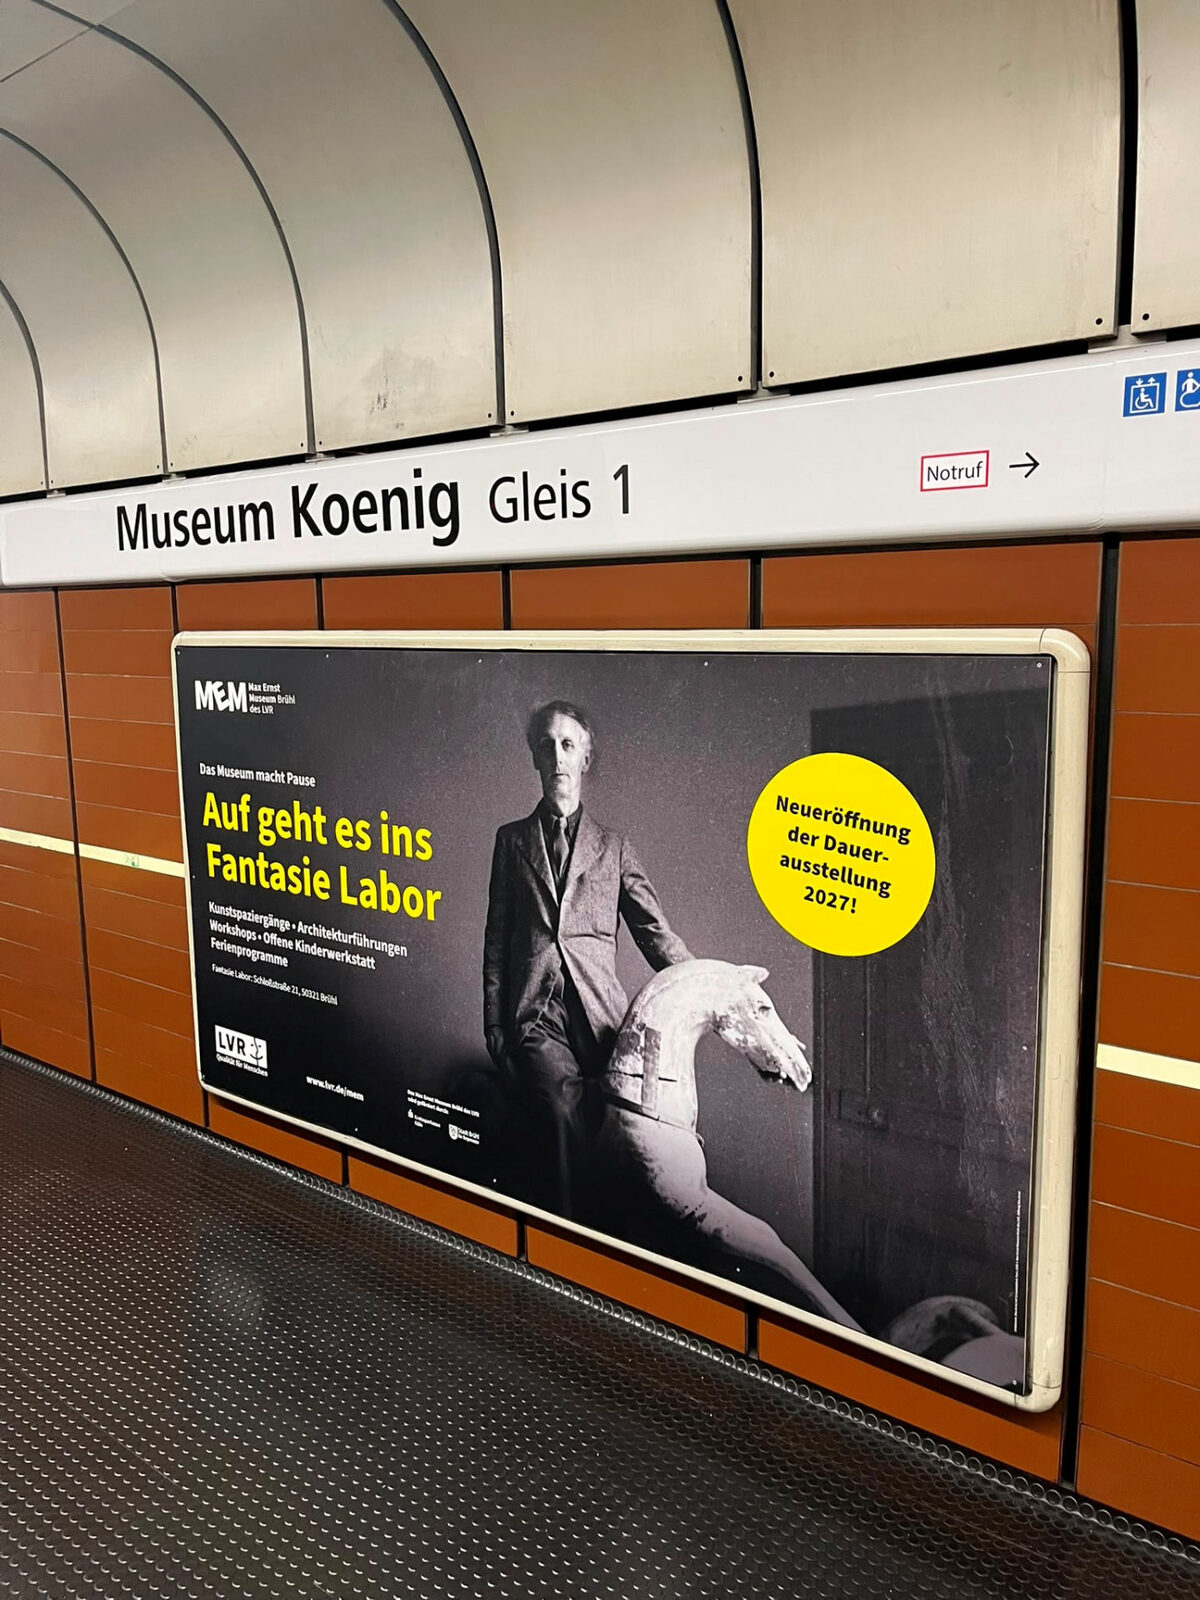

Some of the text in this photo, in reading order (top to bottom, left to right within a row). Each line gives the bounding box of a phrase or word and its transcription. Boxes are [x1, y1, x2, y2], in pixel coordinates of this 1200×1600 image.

[926, 460, 984, 482] Notruf
[116, 464, 630, 551] Museum Koenig Gleis 1
[194, 680, 248, 713] MEM
[248, 682, 281, 693] Max Ernst
[248, 693, 296, 705] Museum Brühl
[249, 704, 274, 715] des LVR
[199, 762, 317, 787] Das Museum macht Pause
[202, 791, 433, 861] Auf geht es ins
[776, 794, 912, 845] Neueröffnung
[787, 826, 890, 864] der Dauer-
[206, 842, 443, 922] Fantasie Labor
[779, 854, 892, 899] ausstellung
[803, 885, 858, 915] 2027!
[208, 901, 408, 957] Kunstspaziergänge Architekturführungen
[209, 918, 376, 970] Workshops Offene Kinderwerkstatt
[210, 937, 289, 967] Ferienprogramme
[211, 963, 235, 978] Fantasie
[234, 969, 253, 983] Labor:
[291, 985, 301, 997] 21,
[301, 987, 320, 1001] 50321
[320, 992, 338, 1006] Brühl
[218, 1031, 247, 1057] LVR
